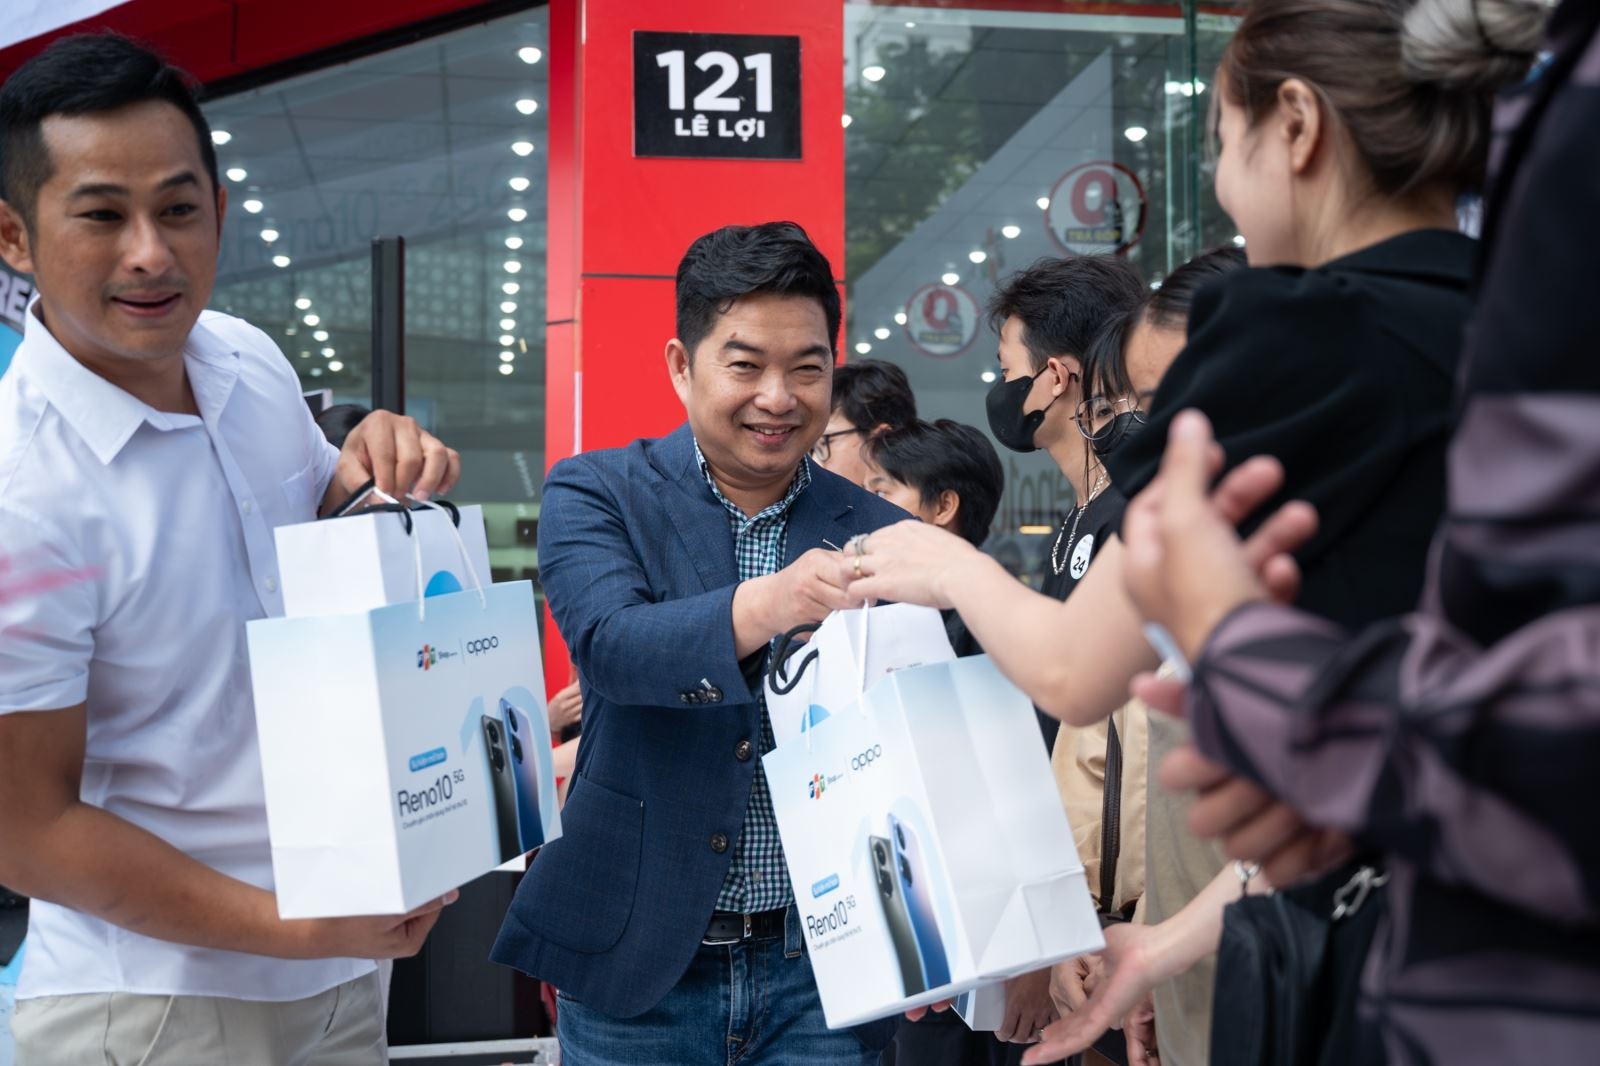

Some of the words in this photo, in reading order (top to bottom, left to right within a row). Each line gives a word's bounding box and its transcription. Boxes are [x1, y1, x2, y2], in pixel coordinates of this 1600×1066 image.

[656, 50, 772, 112] 121
[675, 114, 709, 136] LÊ
[718, 118, 765, 142] LỢI
[1073, 556, 1086, 574] 24
[466, 636, 499, 656] oppo
[851, 744, 882, 771] oppo
[398, 774, 453, 817] Reno10
[453, 768, 465, 784] 5G
[806, 900, 848, 939] Reno10
[846, 894, 857, 910] 5G
